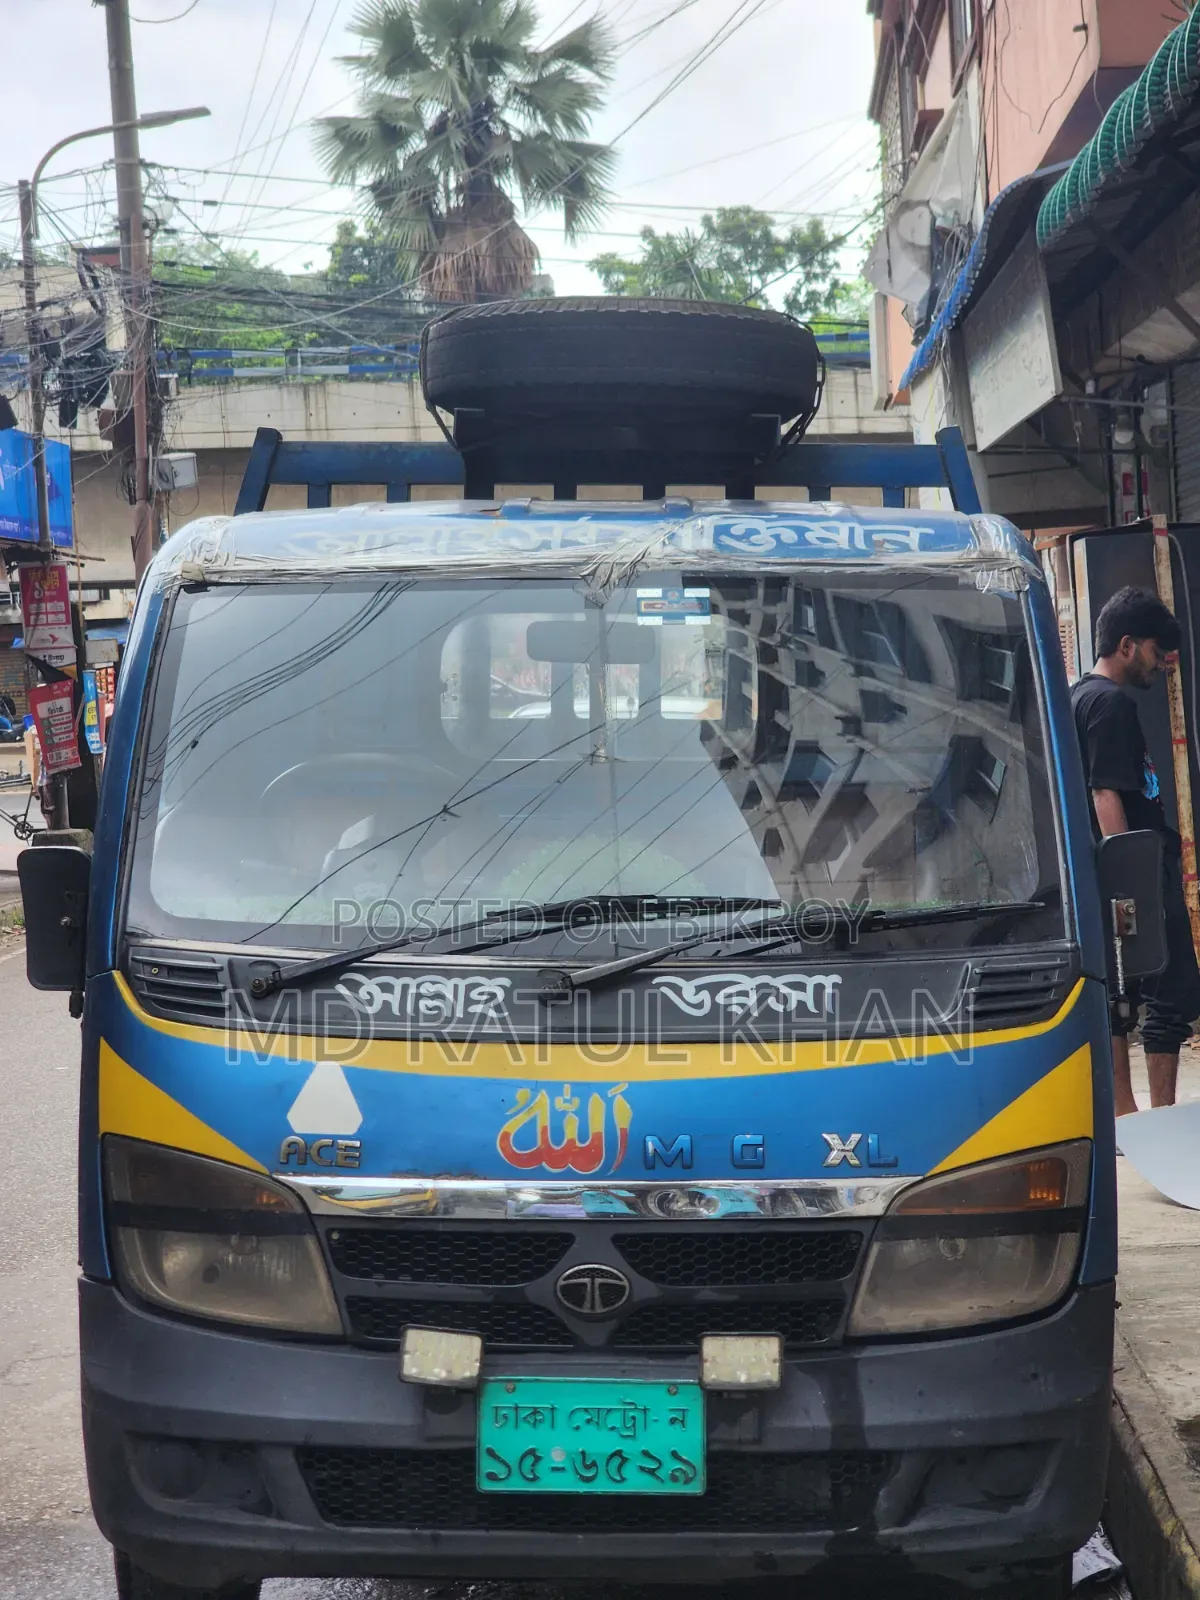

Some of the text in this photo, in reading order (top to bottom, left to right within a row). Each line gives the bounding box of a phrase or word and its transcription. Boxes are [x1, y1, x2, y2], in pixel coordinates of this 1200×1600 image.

[652, 973, 842, 1017] ভরসা
[280, 1135, 361, 1168] ACE
[821, 1132, 899, 1168] XL
[491, 1402, 560, 1432] ঢাকা
[484, 1446, 698, 1486] ১৫-৬৫২৯
